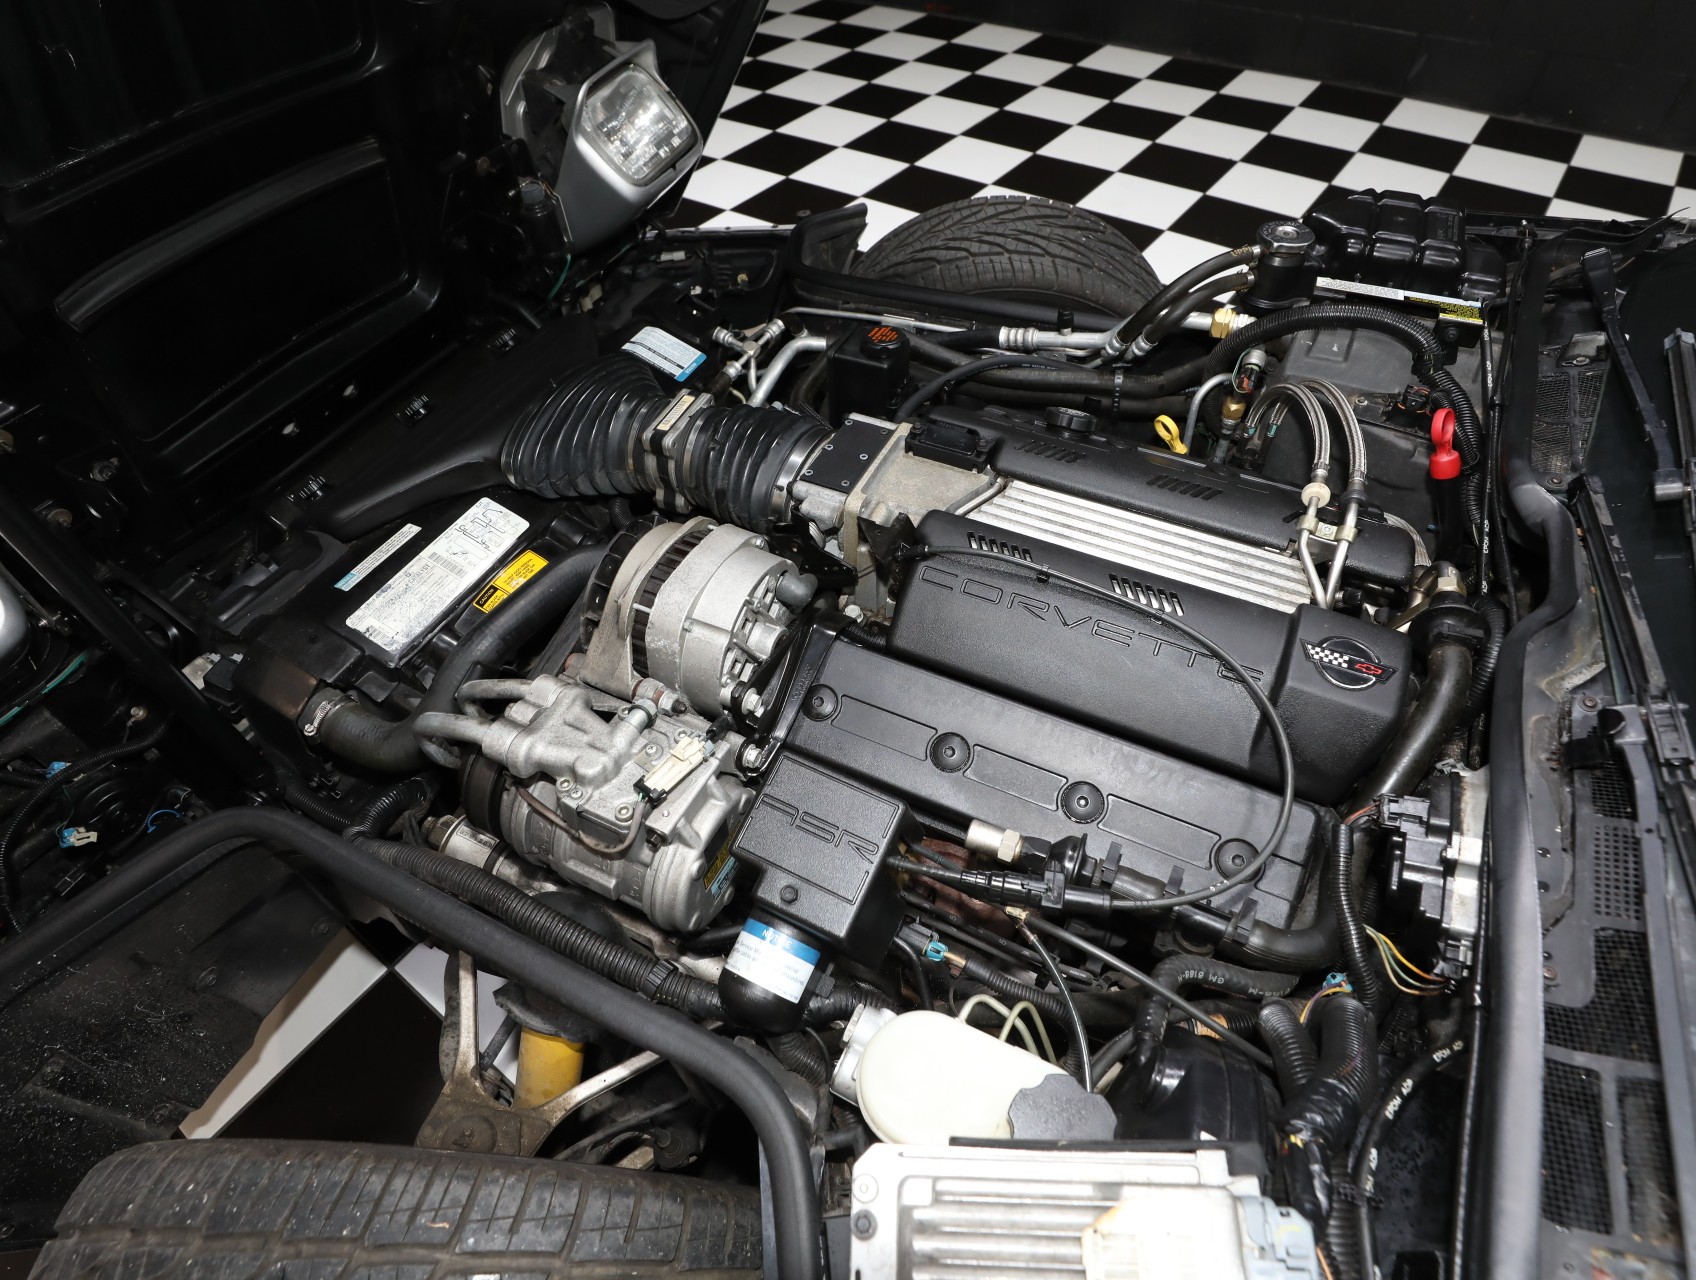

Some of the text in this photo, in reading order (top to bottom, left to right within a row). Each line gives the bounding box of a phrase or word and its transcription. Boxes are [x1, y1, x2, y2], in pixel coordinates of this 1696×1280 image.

[479, 588, 495, 604] CAUTION
[919, 565, 1264, 682] CORVETTE
[756, 793, 880, 864] ASR
[1207, 973, 1225, 984] GM
